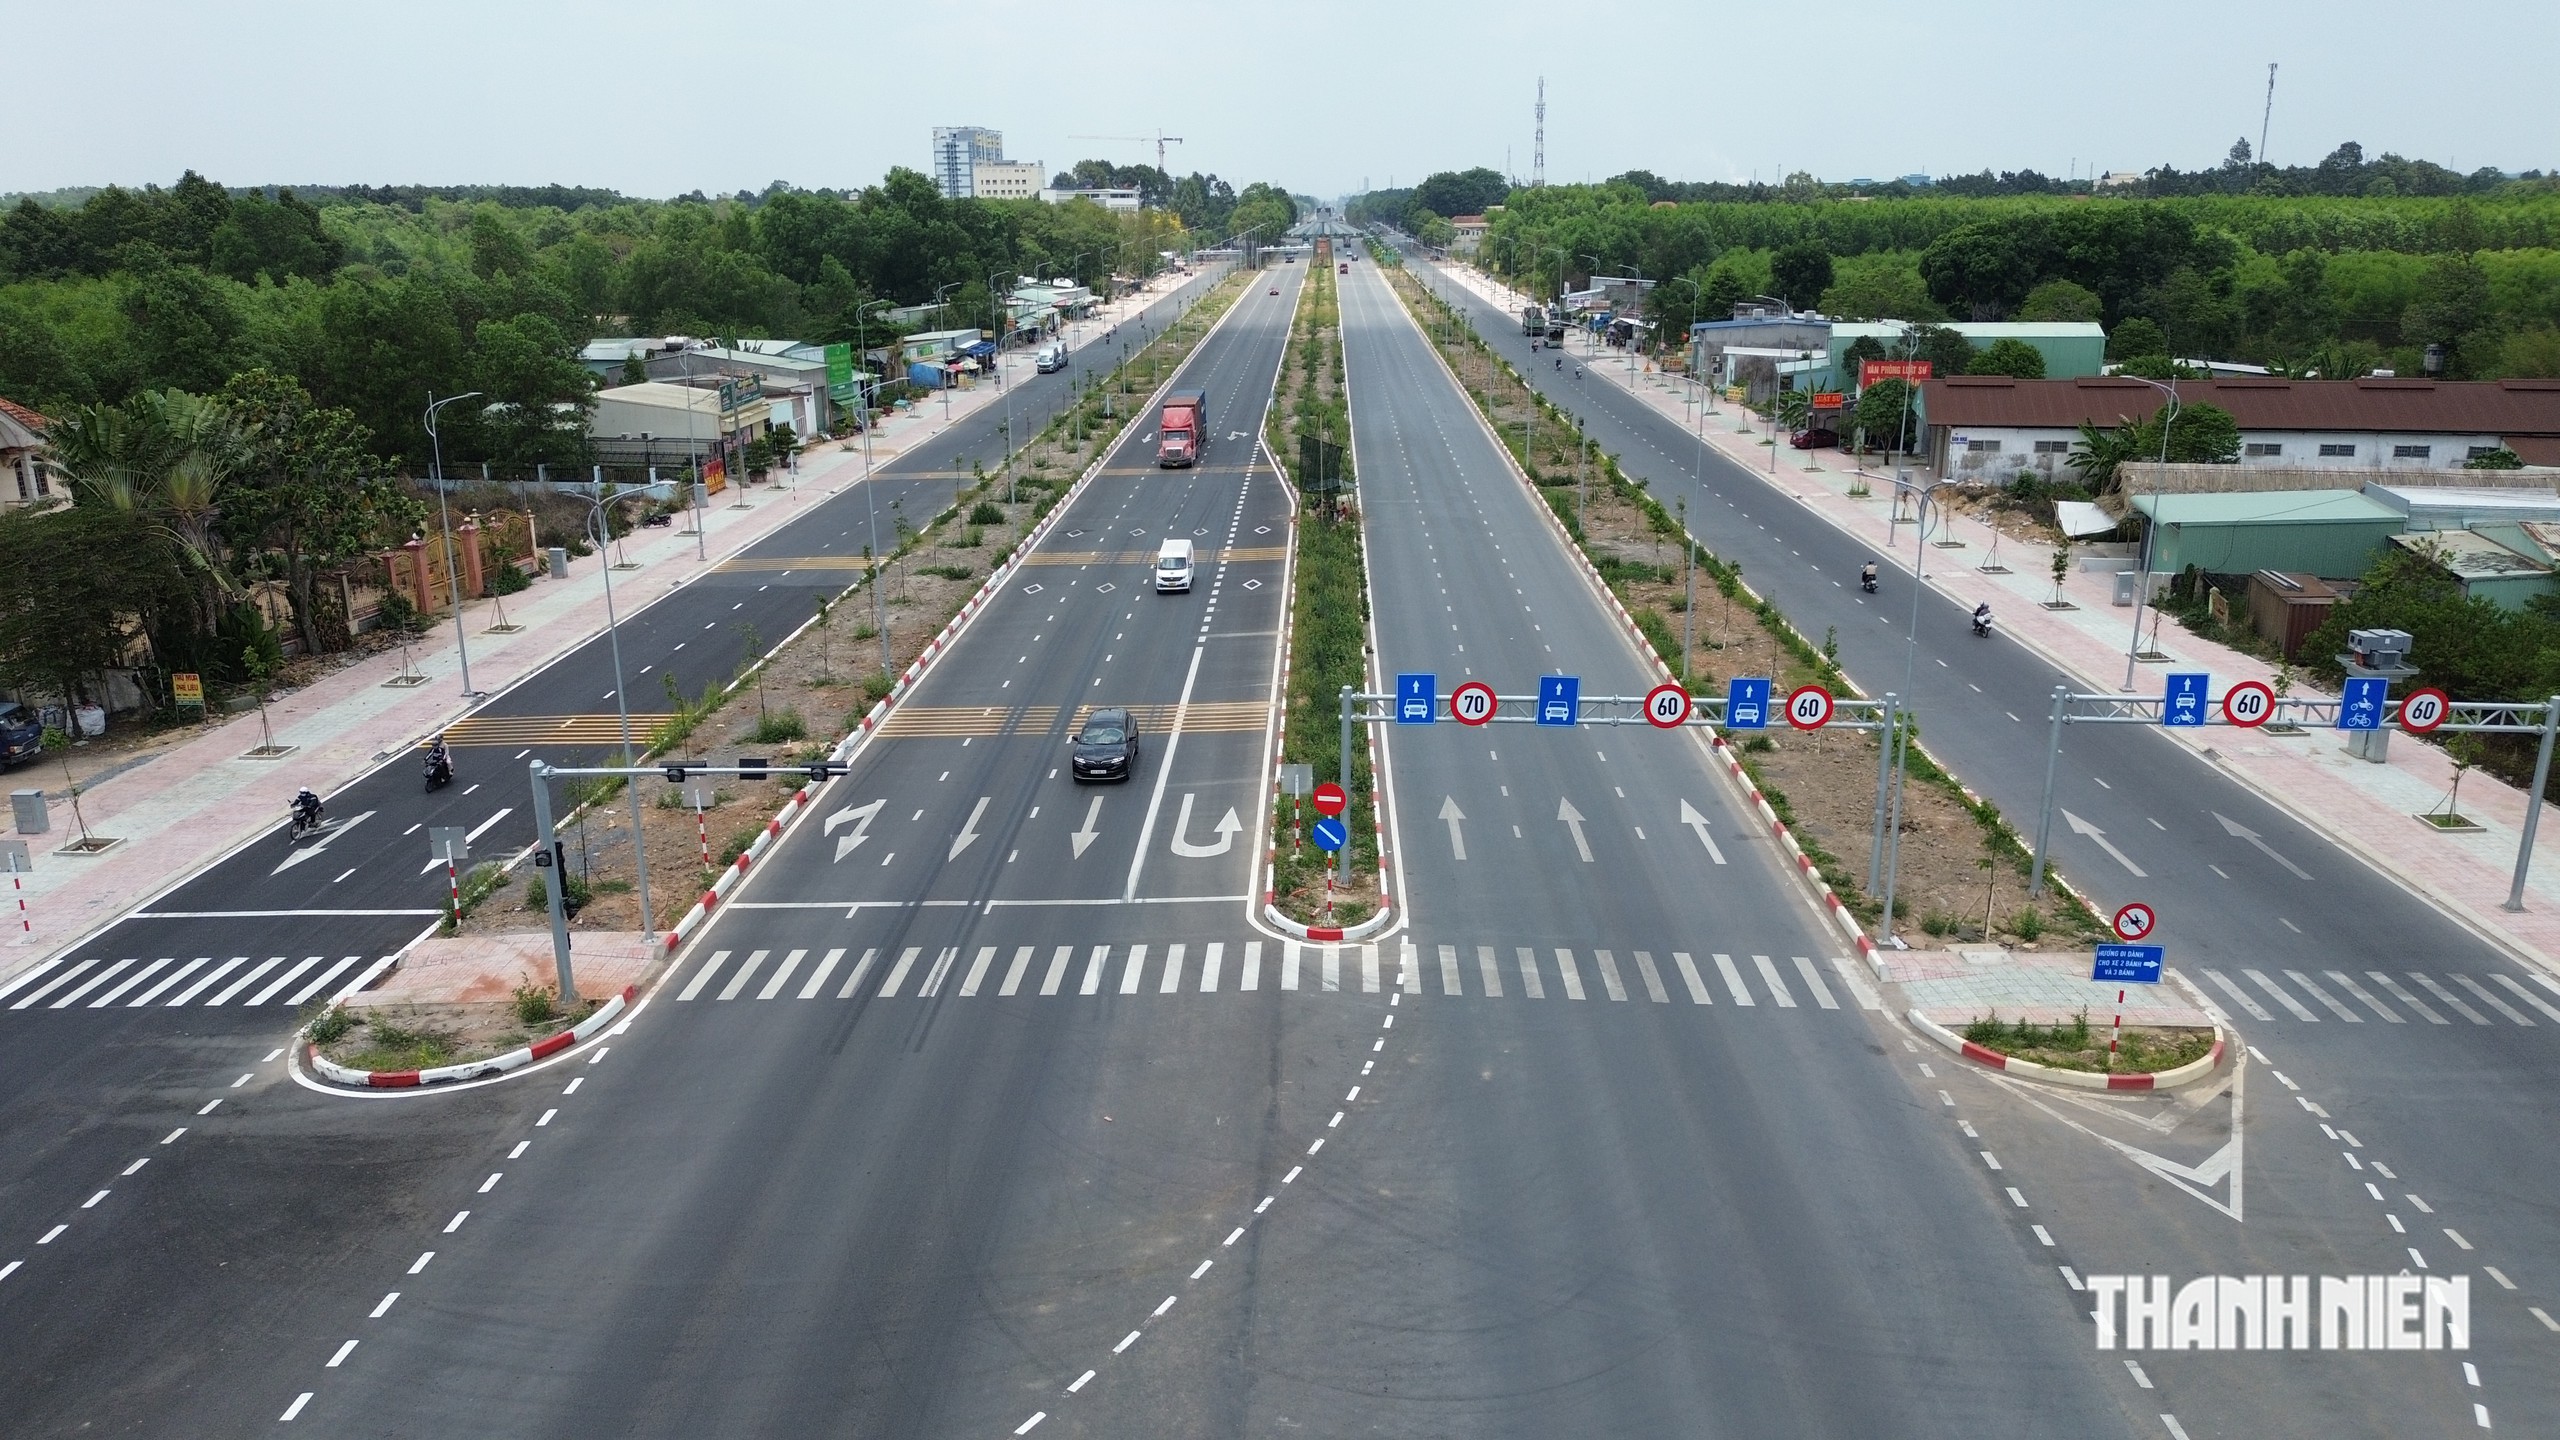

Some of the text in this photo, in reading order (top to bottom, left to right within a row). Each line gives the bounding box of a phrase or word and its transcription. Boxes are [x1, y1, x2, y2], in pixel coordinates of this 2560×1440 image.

[1867, 364, 1928, 375] VĂN PHÒNG LUẬT SƯ
[1815, 394, 1831, 402] LUẬT
[1464, 695, 1484, 714] 70
[1657, 697, 1678, 716] 60
[1797, 698, 1819, 717] 60
[2237, 694, 2261, 715] 60
[2412, 700, 2436, 720] 60
[2098, 948, 2119, 957] HƯỚNG
[2127, 949, 2145, 958] DÀNH
[2125, 958, 2142, 967] BÁNH
[2118, 968, 2135, 976] BÁNH
